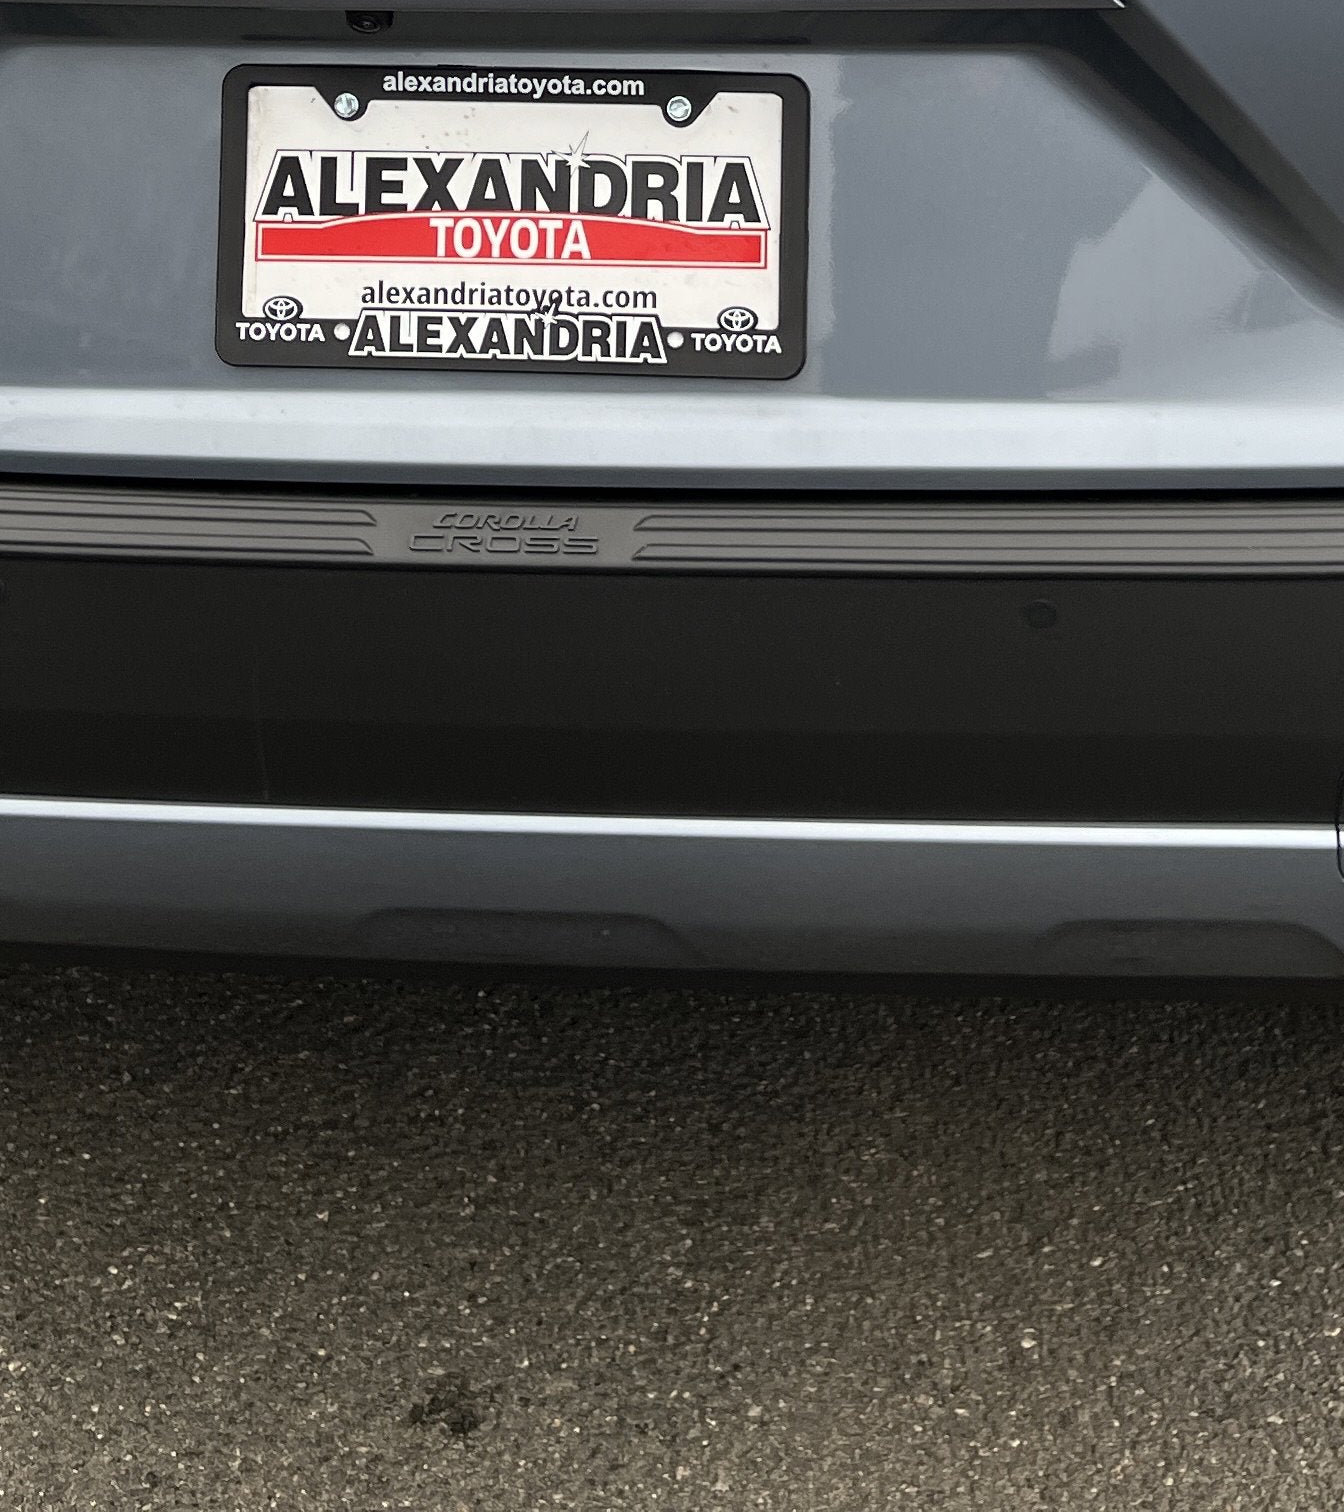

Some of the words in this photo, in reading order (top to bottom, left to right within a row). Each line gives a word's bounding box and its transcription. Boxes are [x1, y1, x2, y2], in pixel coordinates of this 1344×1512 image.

[382, 72, 645, 97] alexandriatoyota.com
[258, 153, 766, 225] ALEXANDRIA
[429, 218, 591, 260] TOYOTA
[361, 281, 657, 309] alexandriatoyota.com
[235, 321, 325, 343] TOYOTA
[350, 312, 666, 363] ALEXANDRIA
[691, 333, 782, 355] TOYOTA
[433, 512, 578, 532] COROLLA
[408, 535, 599, 554] CROSS
